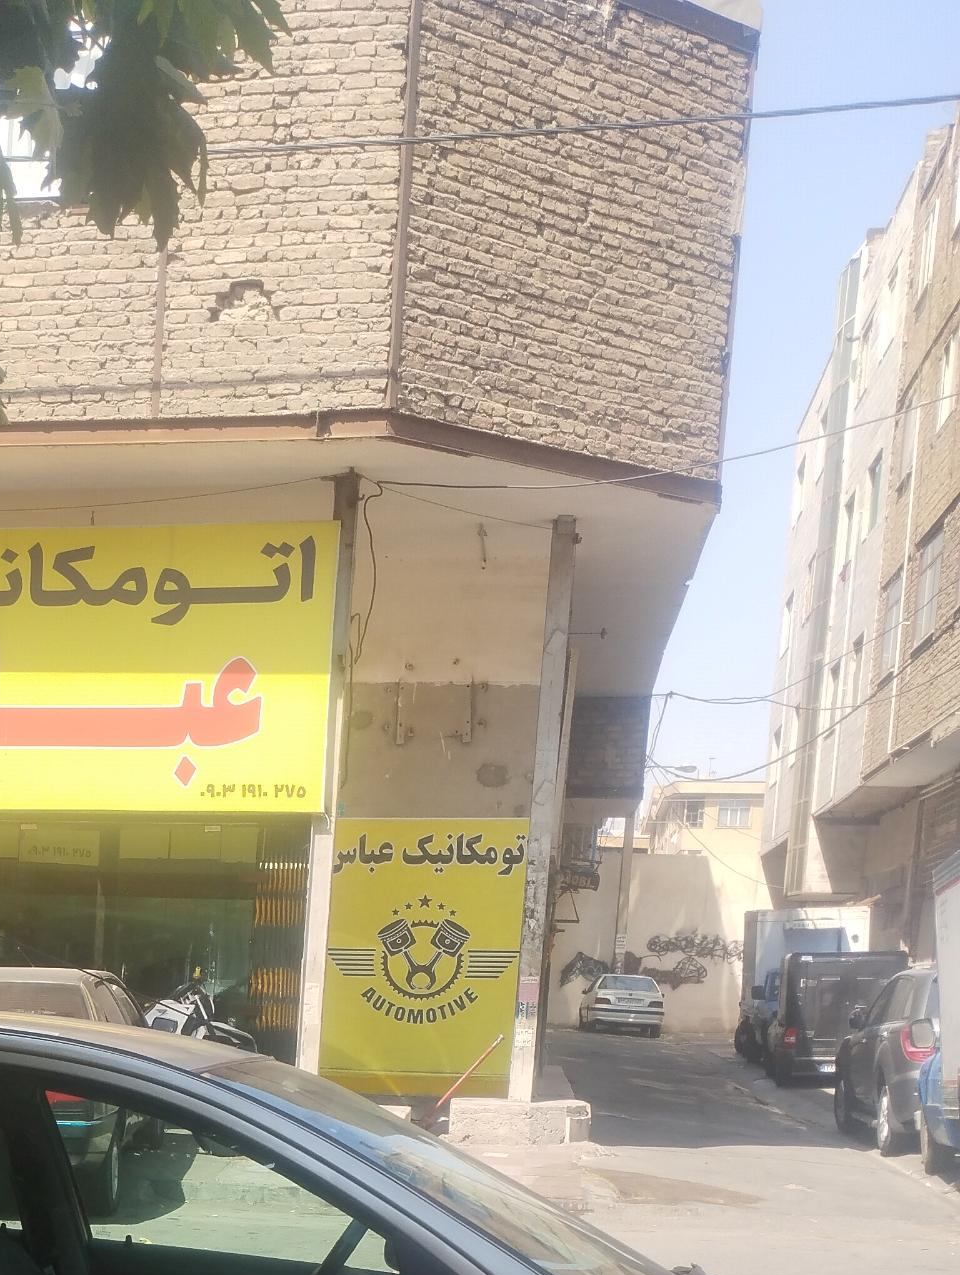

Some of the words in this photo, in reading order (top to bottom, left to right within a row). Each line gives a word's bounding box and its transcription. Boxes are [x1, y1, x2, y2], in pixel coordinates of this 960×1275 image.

[200, 783, 236, 798] ۰۹۰۳
[241, 783, 268, 798] ۱۹۱۰
[274, 784, 307, 798] ۲۷۵
[332, 832, 394, 875] عباس
[402, 832, 528, 876] تومکانیک
[360, 986, 479, 1025] AUTOMOTIVE
